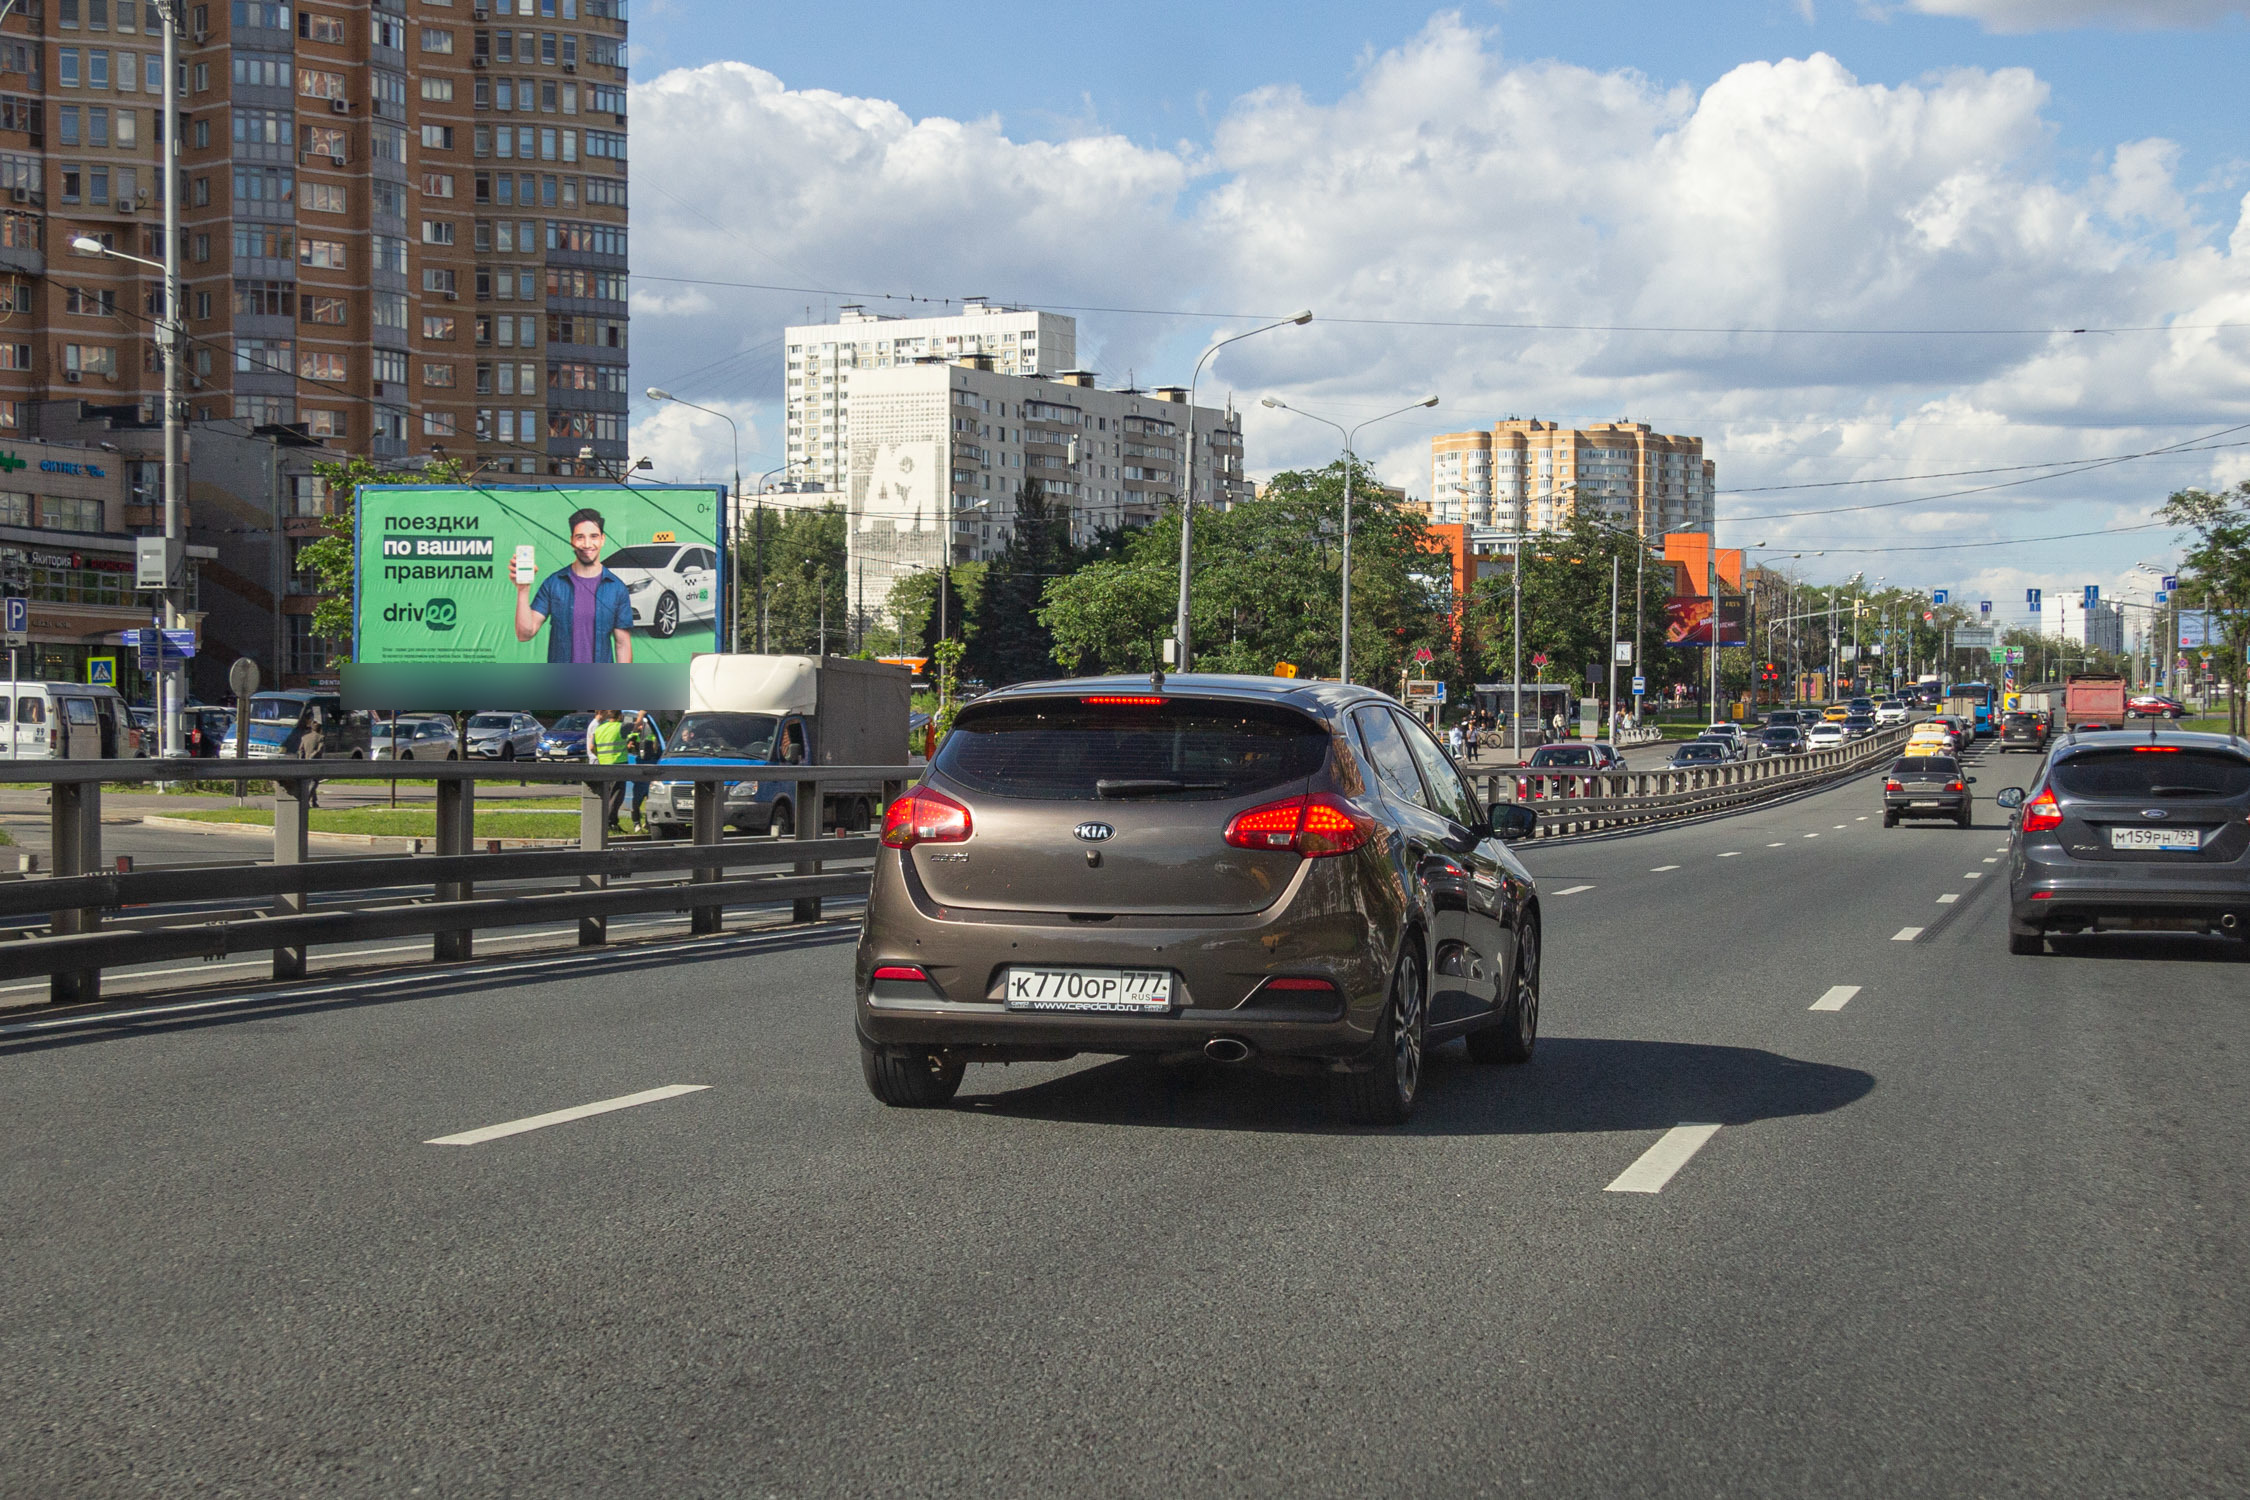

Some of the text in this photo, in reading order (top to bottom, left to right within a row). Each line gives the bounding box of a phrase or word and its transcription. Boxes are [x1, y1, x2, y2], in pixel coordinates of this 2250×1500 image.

[697, 503, 711, 513] 0+
[384, 516, 479, 533] поездки
[384, 540, 493, 555] по вашим
[31, 551, 72, 568] Якитория
[384, 565, 493, 584] правилам
[12, 601, 24, 629] P
[383, 602, 457, 626] drivee
[36, 727, 45, 736] 99
[1080, 825, 1108, 838] KIA
[2174, 830, 2195, 841] 799
[1123, 972, 1164, 994] 777
[1131, 993, 1151, 1001] RUS
[1034, 1002, 1139, 1012] www.ceedclub.ru
